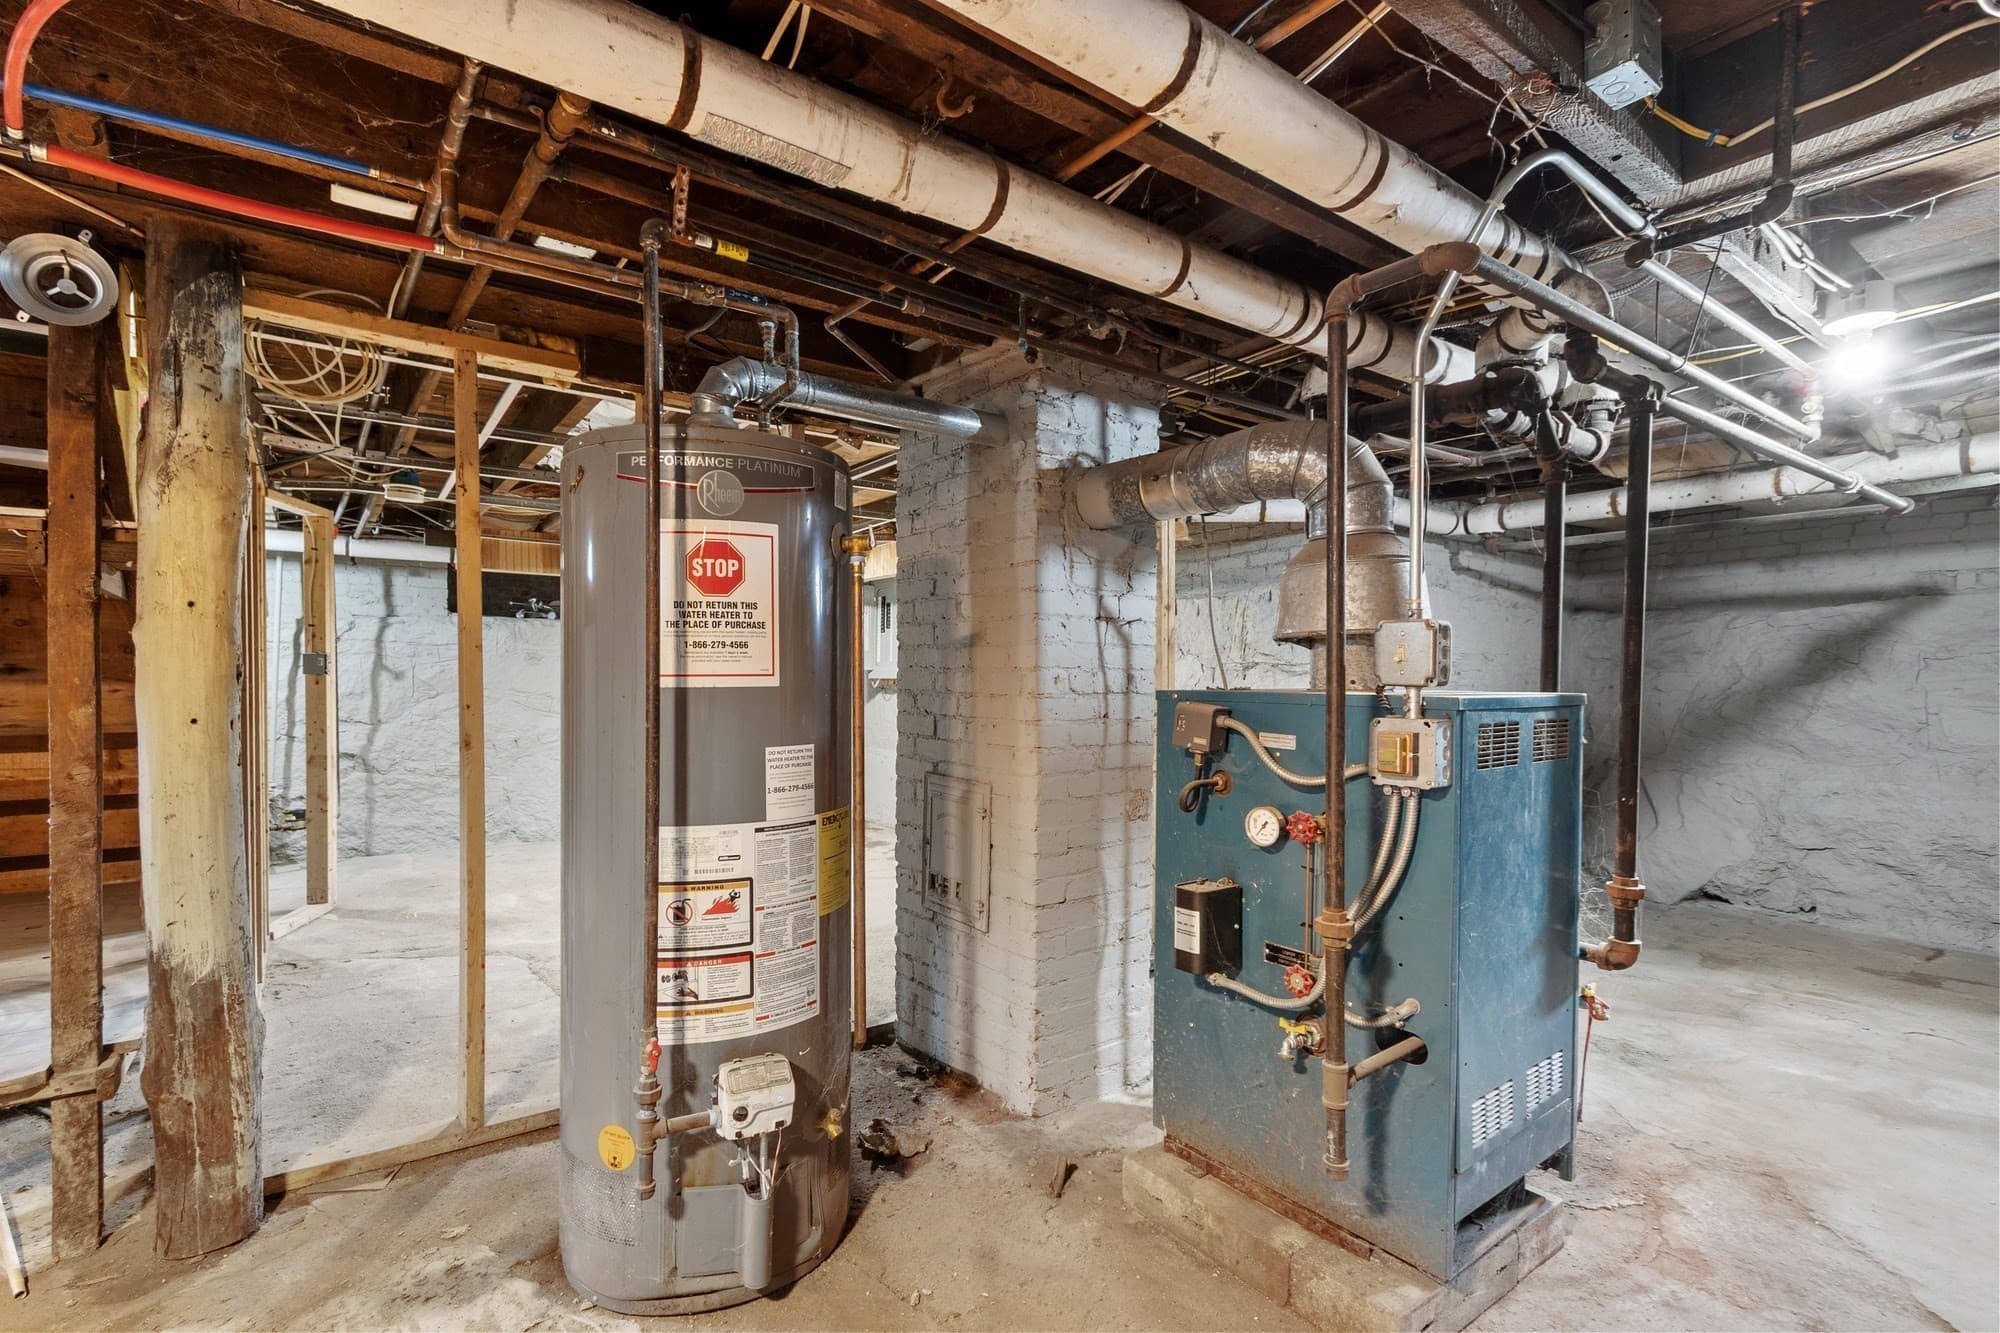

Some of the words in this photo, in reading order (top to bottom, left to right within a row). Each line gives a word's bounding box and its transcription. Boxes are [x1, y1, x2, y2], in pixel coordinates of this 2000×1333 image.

[631, 455, 734, 469] PEFORMANCE
[738, 458, 801, 478] PLATINUM
[703, 472, 743, 509] Rheem
[692, 558, 739, 578] STOP
[673, 600, 685, 609] DO
[687, 600, 703, 609] NOT
[706, 601, 738, 609] RETURN
[741, 602, 758, 610] THIS
[678, 610, 707, 619] WATER
[709, 611, 740, 619] HEATER
[743, 612, 753, 620] TO
[664, 620, 681, 629] THE
[683, 620, 709, 629] PLACE
[712, 621, 722, 629] OF
[725, 621, 767, 630] PURCHASE
[684, 641, 749, 649] 1-866-279-4566
